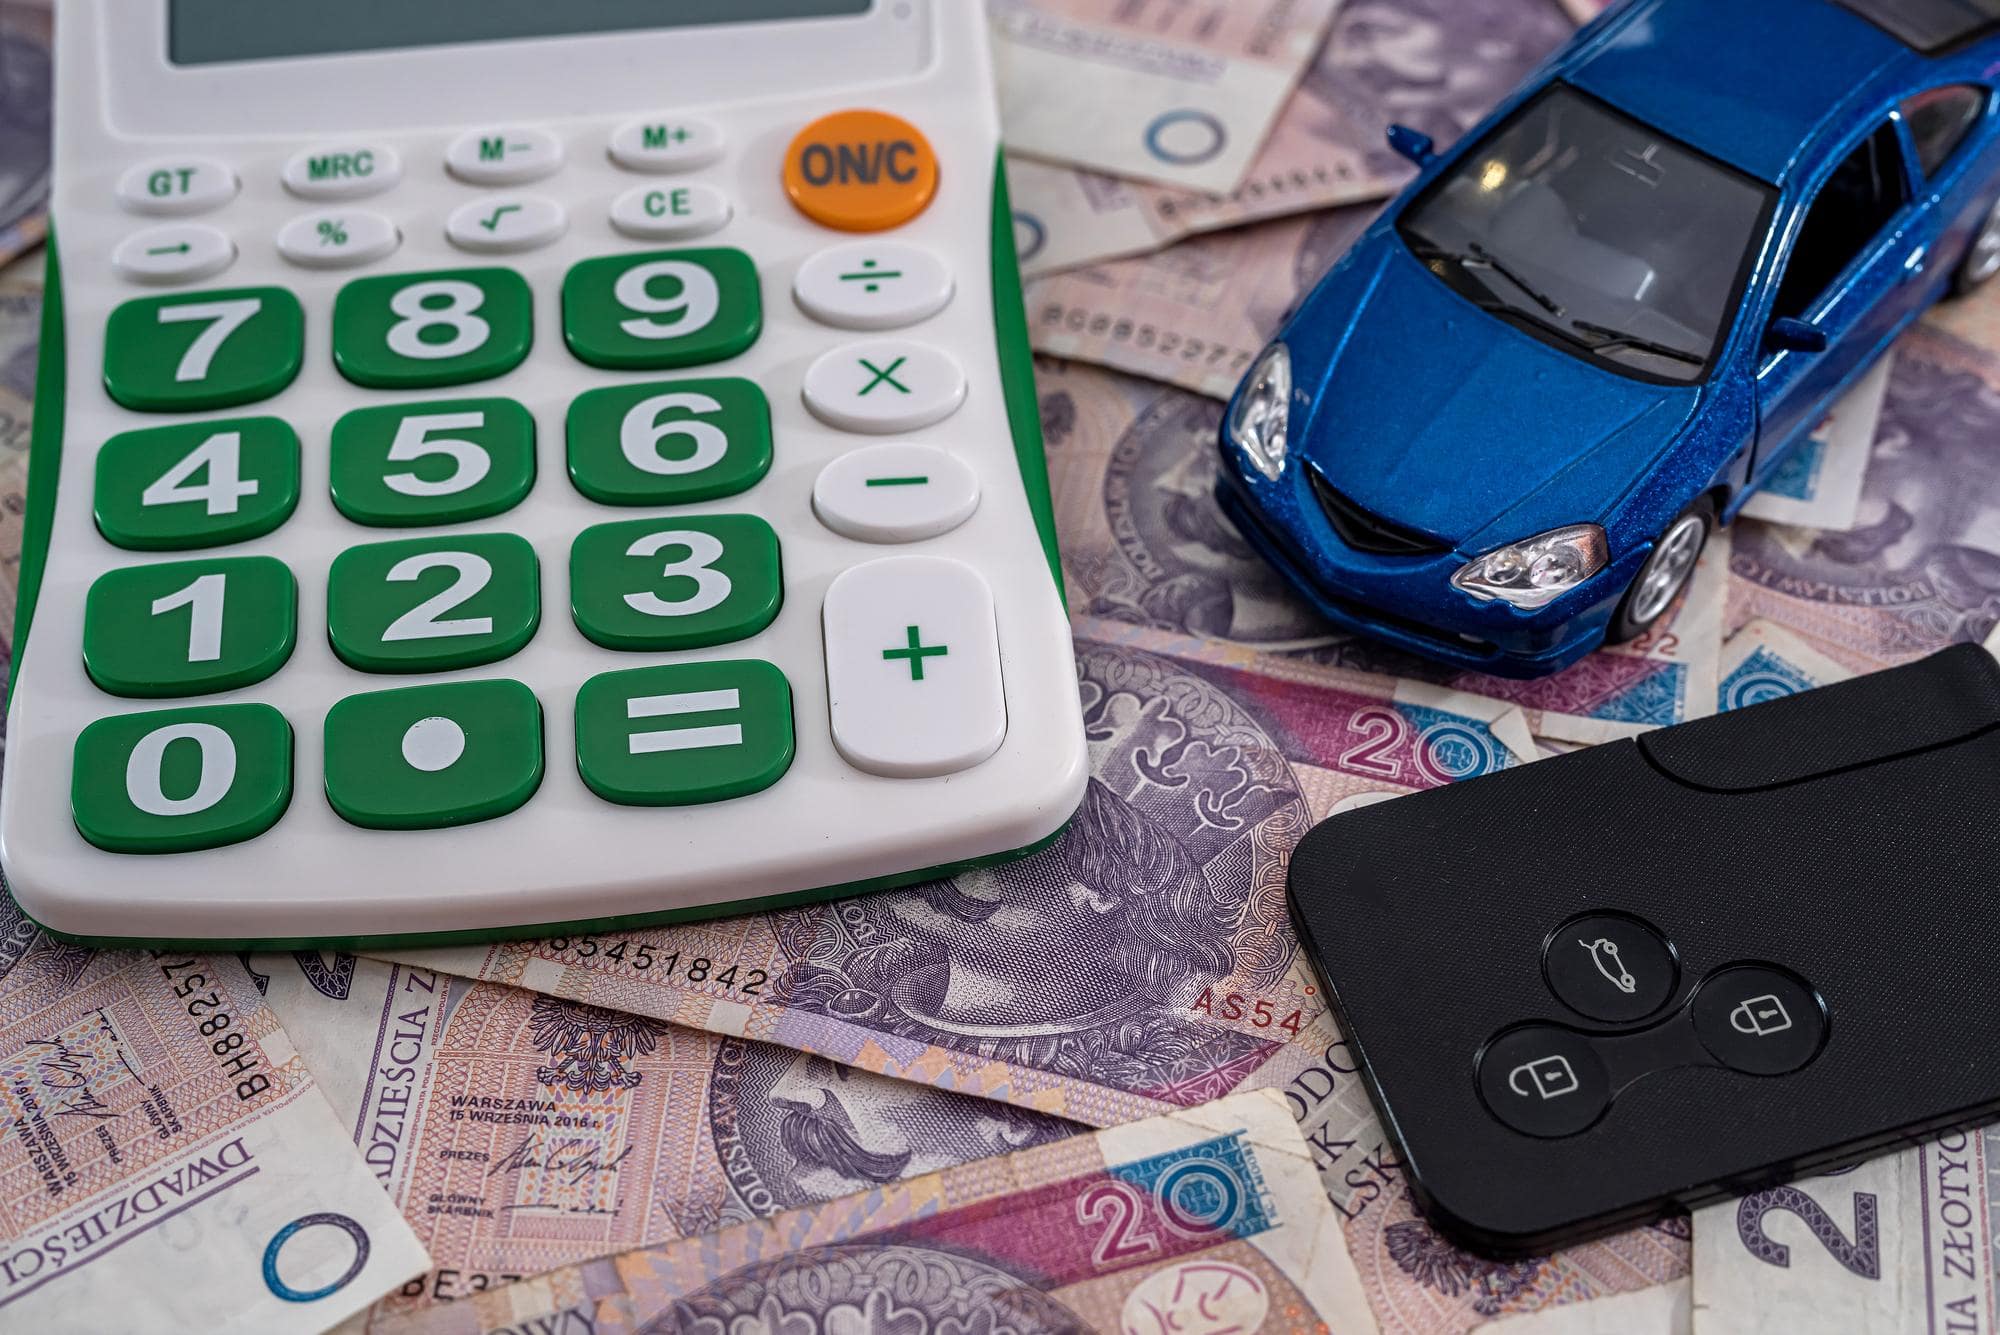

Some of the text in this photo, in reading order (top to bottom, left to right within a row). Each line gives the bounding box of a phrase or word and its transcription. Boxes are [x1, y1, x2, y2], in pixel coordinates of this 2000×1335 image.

[308, 151, 374, 181] MRC
[643, 126, 692, 150] M+
[801, 140, 917, 186] ON/C
[147, 168, 198, 197] GT
[645, 191, 690, 217] CE
[385, 280, 491, 360] 8
[614, 260, 720, 340] 9
[156, 299, 262, 382] 7
[142, 432, 258, 516] 4
[382, 411, 491, 497] 5
[620, 392, 729, 476] 6
[381, 551, 493, 641] 2
[623, 530, 733, 617] 3
[150, 574, 226, 663] 1
[125, 722, 237, 817] 0
[1339, 705, 1494, 787] 20
[158, 955, 271, 1101] BH88257
[1193, 987, 1301, 1036] AS54
[16, 1087, 39, 1113] 2016
[148, 1084, 183, 1134] SKARBNIK
[449, 1110, 464, 1122] 15
[469, 1110, 549, 1126] WRZEŚNIA
[554, 1116, 588, 1128] 2016
[451, 1096, 556, 1112] WARSZAWA
[14, 1116, 64, 1197] WARSZAWA
[32, 1112, 70, 1172] WRZEŚNIA
[64, 1172, 78, 1187] 15
[95, 1124, 123, 1165] PREZES
[439, 1150, 490, 1162] PREZES
[1, 1137, 254, 1286] DWADZIEŚCI
[427, 1206, 494, 1219] SKARBNIK
[1076, 1157, 1246, 1269] 20
[1738, 1184, 1880, 1281] 2
